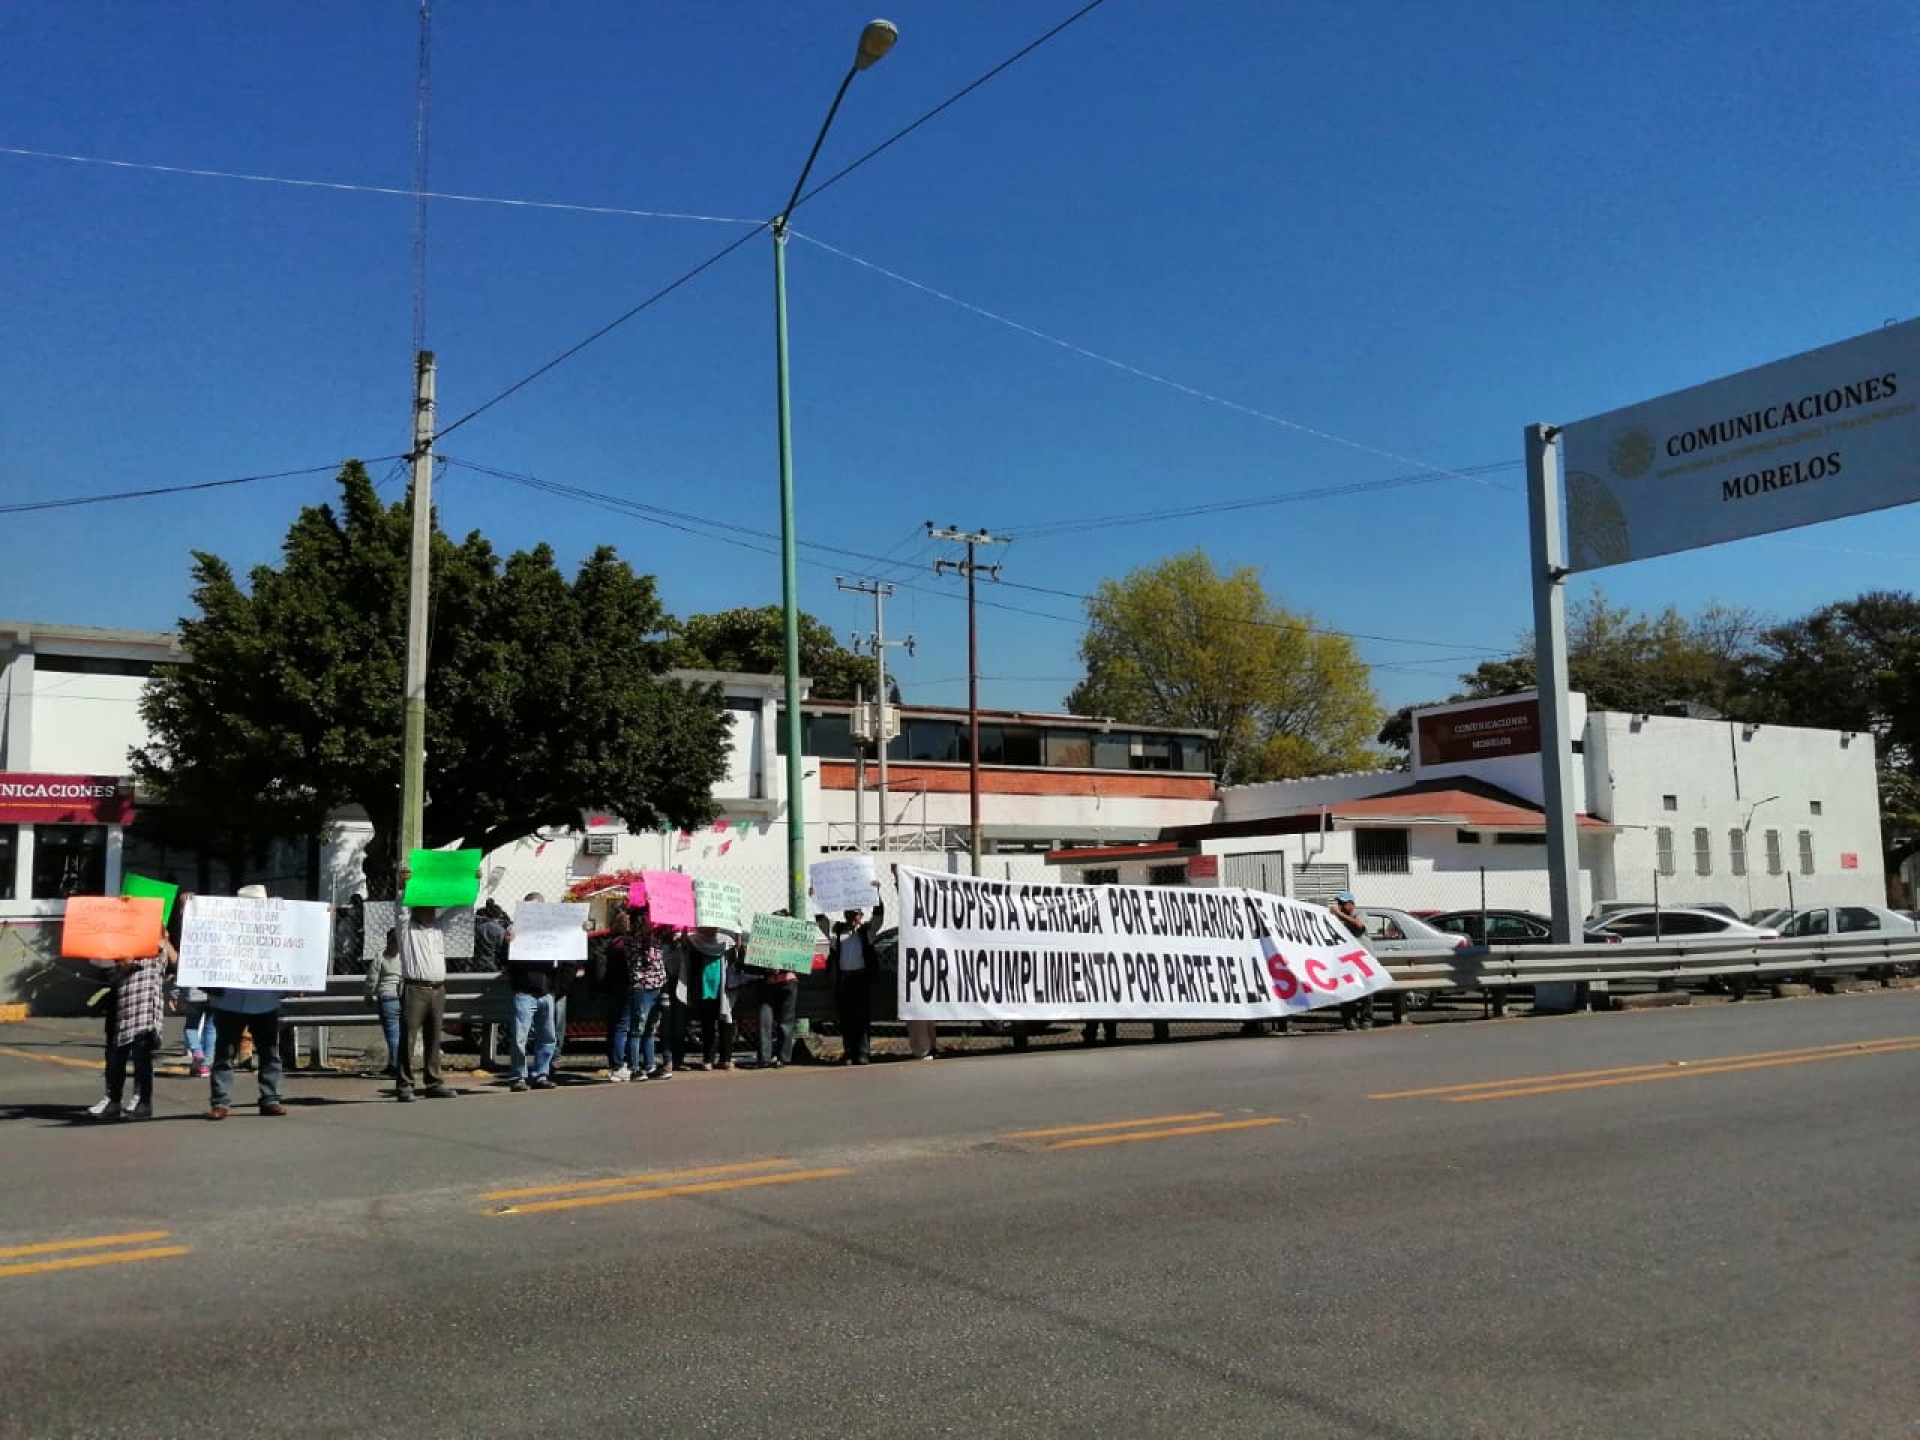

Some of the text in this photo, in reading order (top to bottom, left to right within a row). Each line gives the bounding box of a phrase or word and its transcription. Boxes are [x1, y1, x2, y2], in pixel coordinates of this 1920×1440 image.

[1667, 373, 1897, 457] COMUNICACIONES
[1722, 452, 1842, 501] MORELOS
[1454, 715, 1528, 733] COMUNICACIONES
[0, 783, 115, 798] NICACIONES
[913, 876, 1020, 930] AUTOPISTA
[1020, 885, 1103, 934] CERRADA
[1108, 888, 1147, 935] POR
[1144, 890, 1244, 939] EJIDATARIOS
[1243, 896, 1272, 939] DE
[1272, 901, 1347, 947] JOJUTLA
[905, 948, 950, 1003] POR
[954, 949, 1121, 1003] INCUMPLIMIENTO
[1122, 951, 1165, 1003] POR
[1163, 953, 1218, 1003] PARTE
[1216, 956, 1242, 1003] DE
[1239, 957, 1271, 1003] LA
